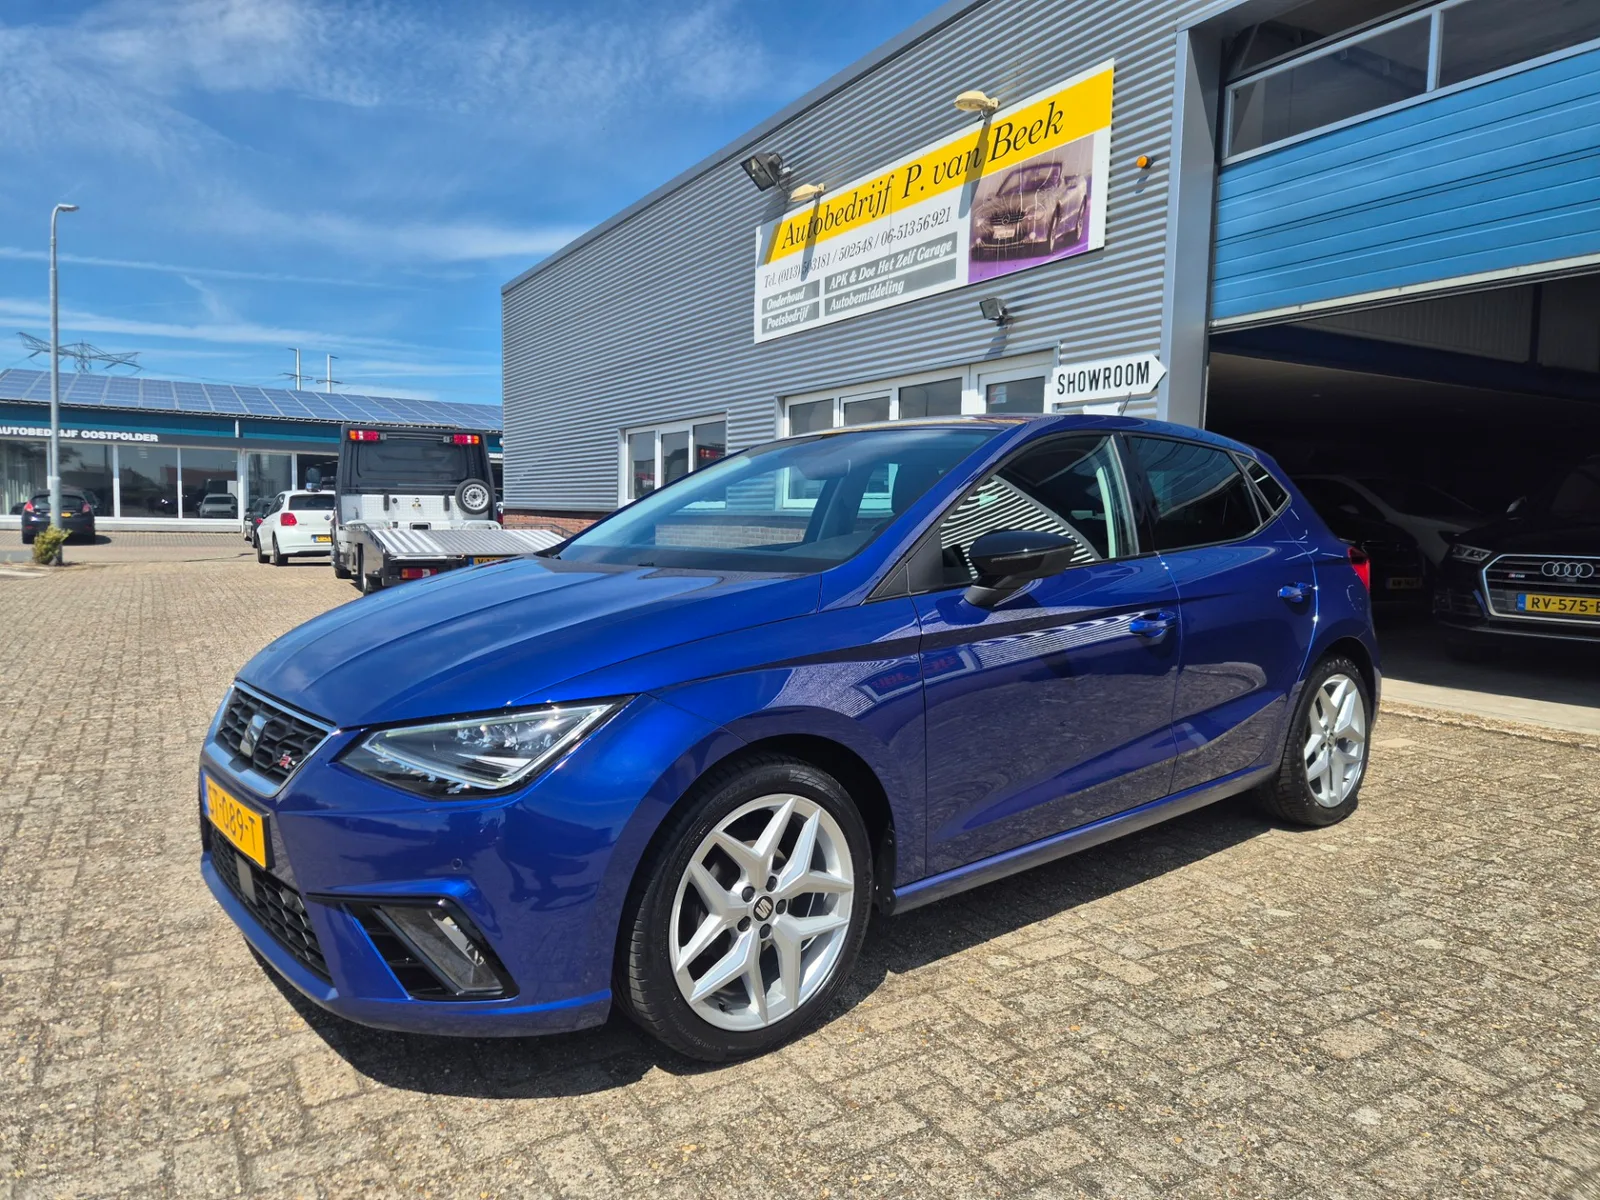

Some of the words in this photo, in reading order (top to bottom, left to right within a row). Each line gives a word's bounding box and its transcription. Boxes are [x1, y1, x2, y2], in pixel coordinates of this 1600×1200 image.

[781, 174, 894, 250] Autobedrijf
[902, 164, 924, 199] P.
[933, 147, 981, 185] van
[988, 101, 1064, 163] Beek
[764, 272, 776, 288] Tel.
[778, 264, 801, 286] (0113)
[839, 236, 873, 261] 502548
[829, 273, 849, 290] APK
[849, 270, 857, 280] &
[858, 265, 875, 281] Doe
[877, 259, 894, 275] Het
[895, 249, 916, 268] Zelf
[917, 240, 953, 262] Garage
[766, 286, 806, 310] Onderhoud
[829, 280, 905, 312] Autobemiddeling
[766, 305, 810, 329] Poetsbedrijf
[1057, 361, 1150, 395] SHOWROOM
[0, 426, 78, 438] UTOBEDIJF
[81, 430, 159, 442] OOSTPOLDER
